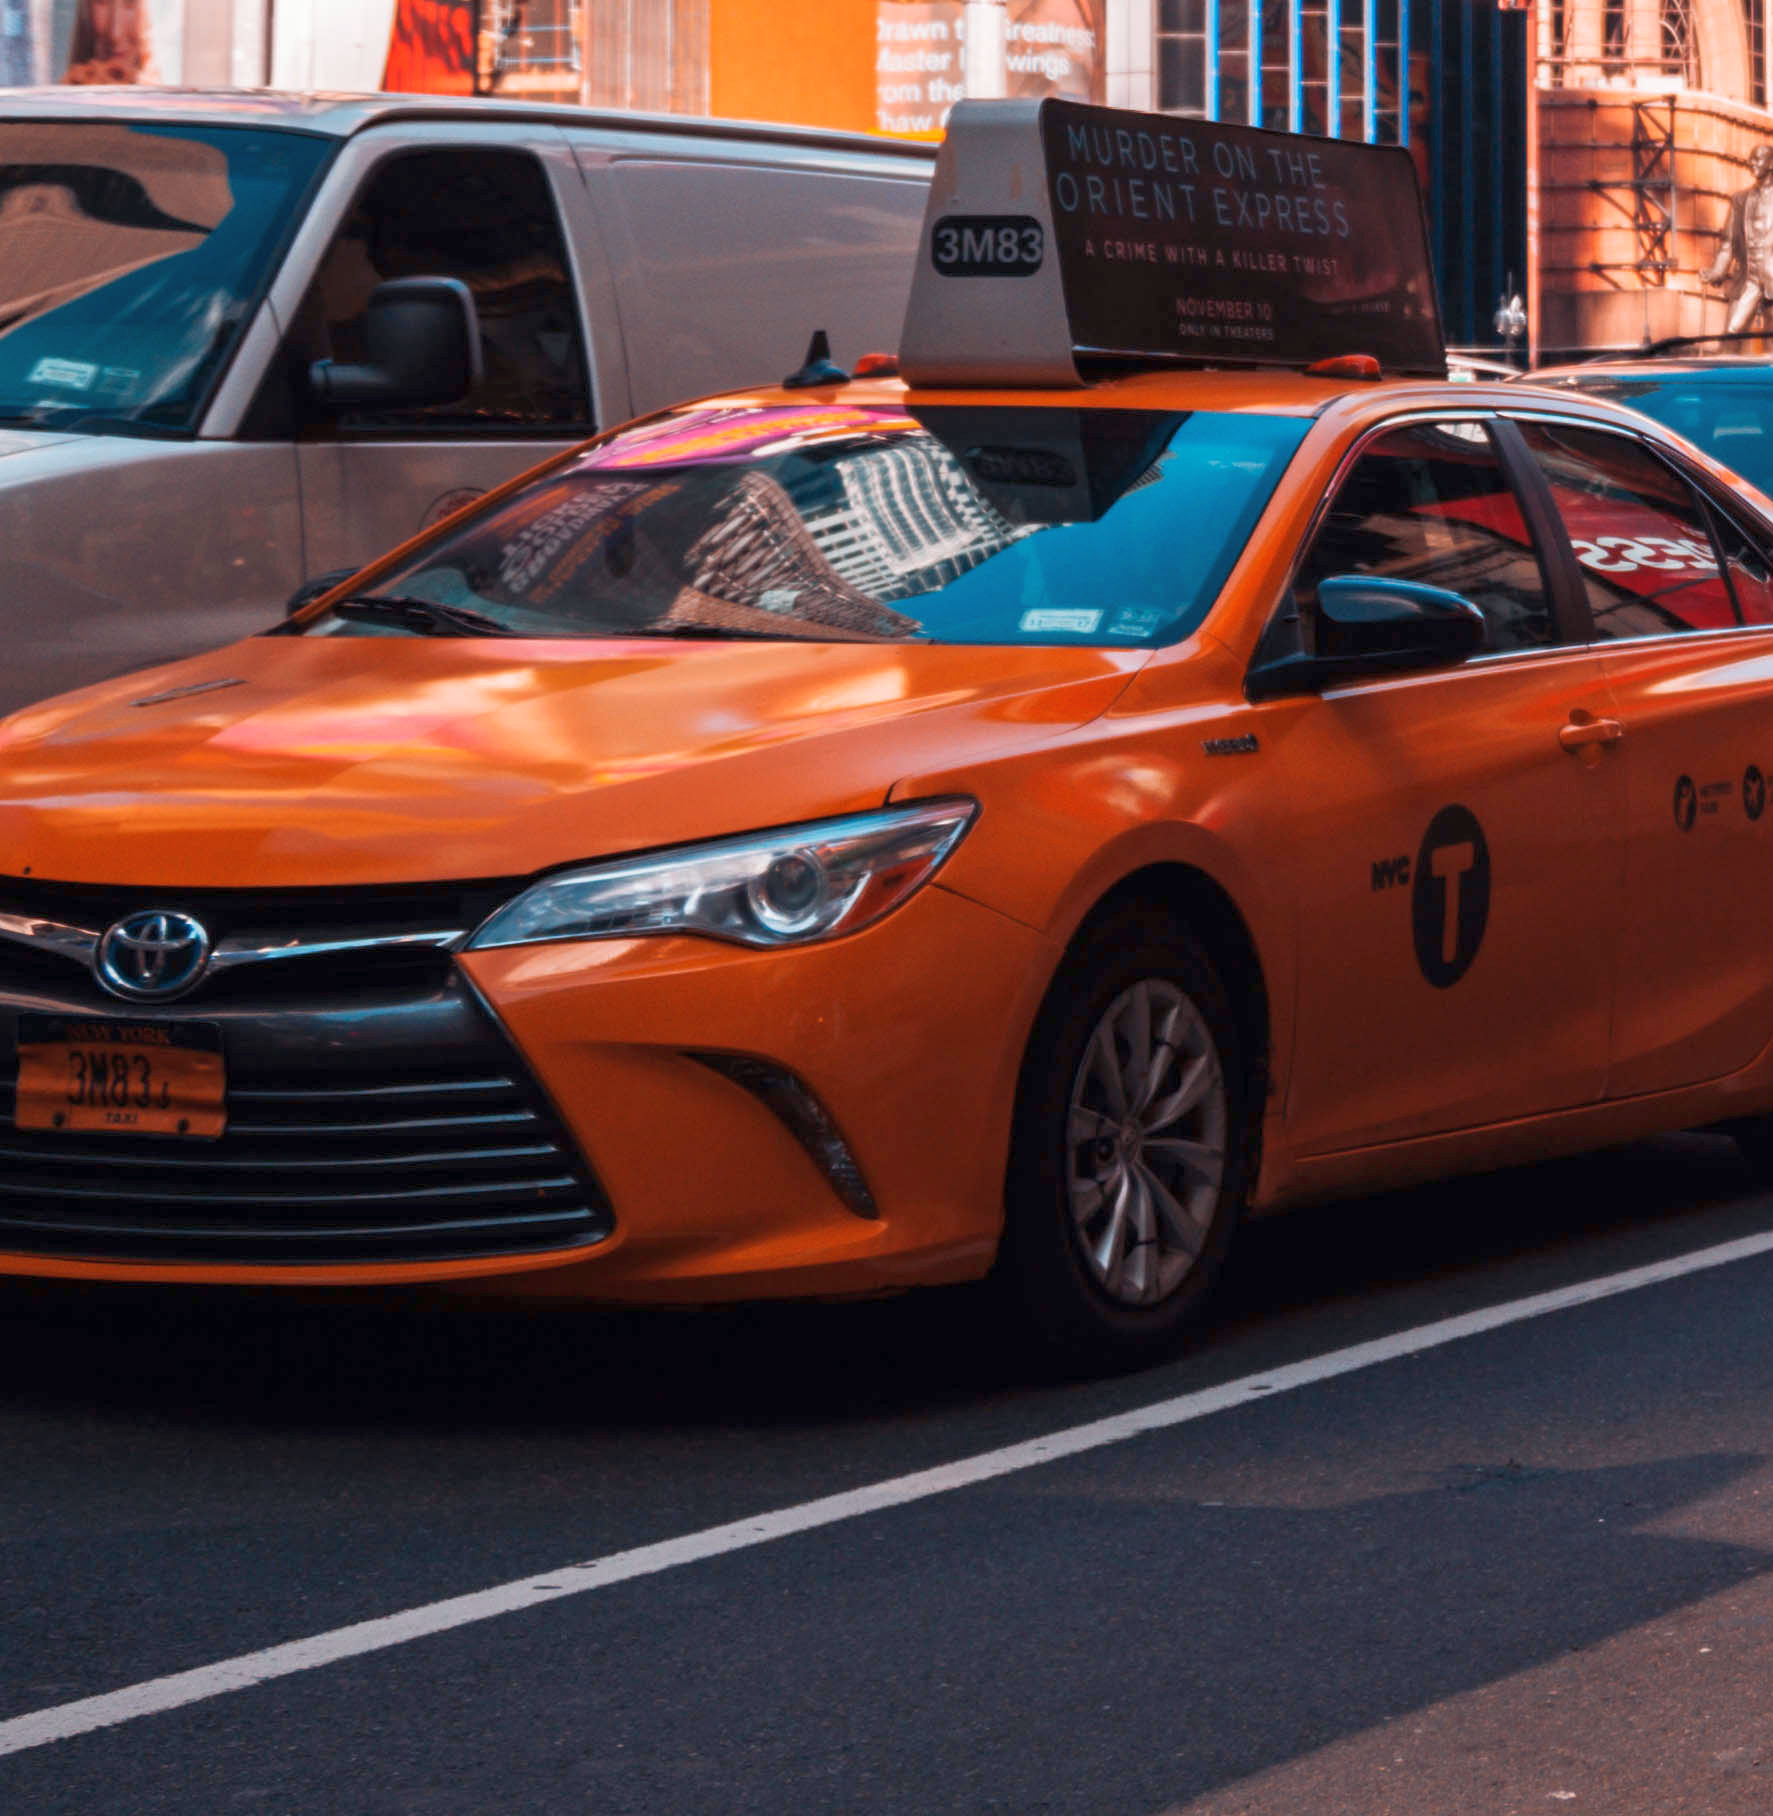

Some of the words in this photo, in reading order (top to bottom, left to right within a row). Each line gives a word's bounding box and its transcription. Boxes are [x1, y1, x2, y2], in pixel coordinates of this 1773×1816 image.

[1067, 124, 1200, 175] MURDER
[1213, 141, 1257, 181] ON
[1267, 148, 1327, 190] THE
[1056, 171, 1197, 224] ORIENT
[1215, 187, 1351, 239] EXPRESS
[936, 227, 1043, 265] 3M83
[1085, 239, 1097, 257] A
[1103, 239, 1158, 263] CRIME
[1164, 246, 1208, 266] WITH
[1215, 251, 1226, 268] A
[1231, 250, 1292, 273] KILLER
[1295, 255, 1340, 276] TWIST
[1175, 296, 1254, 320] NOVEMBER
[1256, 301, 1273, 321] 10
[1178, 322, 1205, 337] ONLY
[1209, 324, 1222, 336] IN
[1223, 324, 1275, 342] THEATERS
[1371, 855, 1410, 892] NYC
